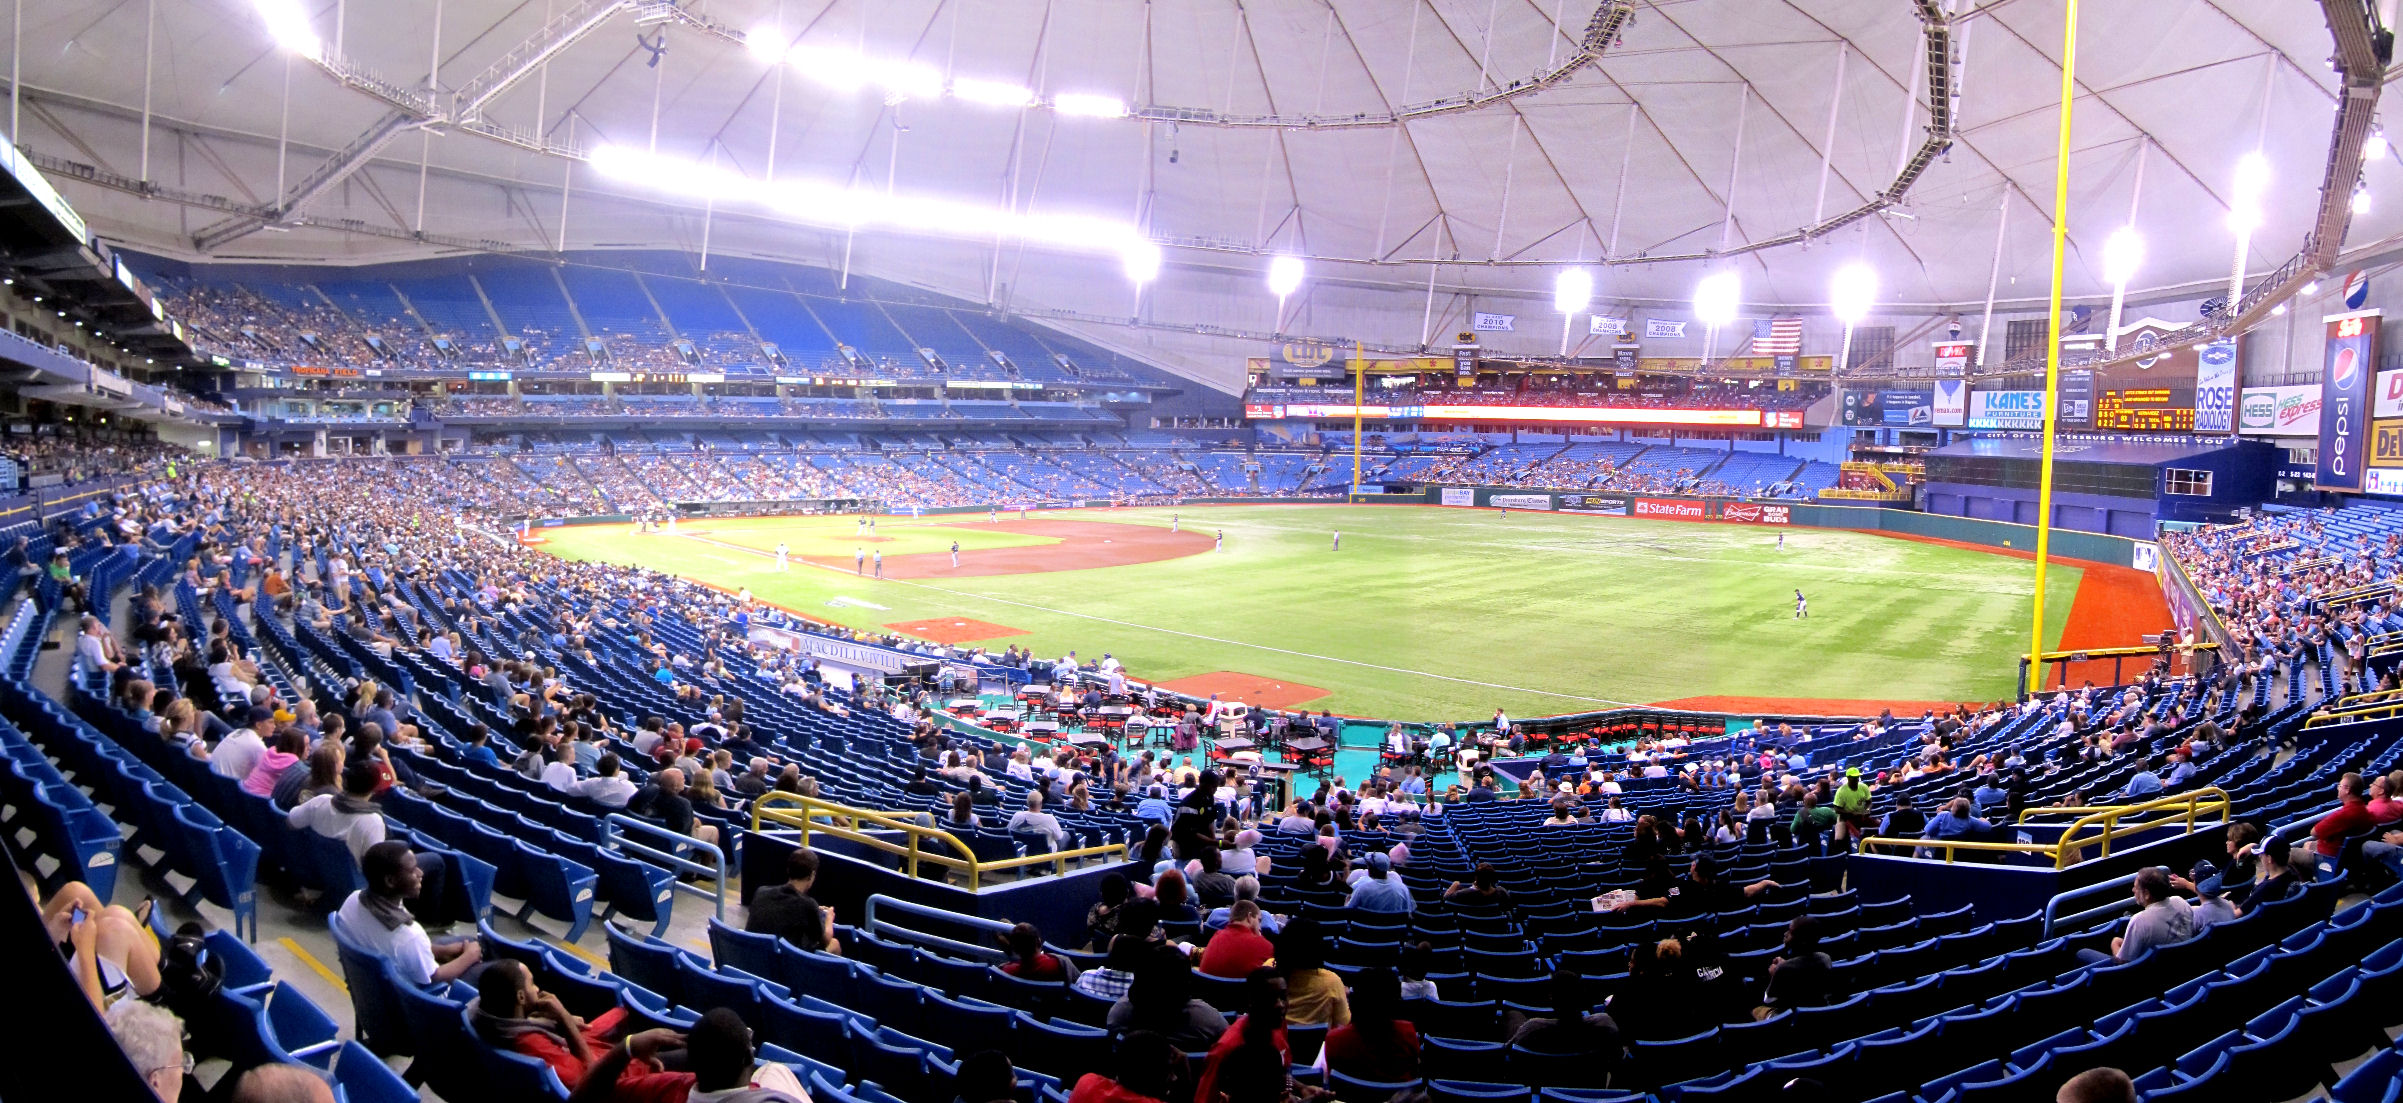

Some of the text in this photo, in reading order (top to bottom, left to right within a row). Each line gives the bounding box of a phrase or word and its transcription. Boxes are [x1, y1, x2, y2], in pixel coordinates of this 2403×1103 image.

[291, 366, 358, 376] TROPICANA FIELD
[1985, 392, 2042, 409] KANE'S
[2196, 387, 2233, 410] ROSE
[2277, 394, 2304, 411] HESS
[2244, 404, 2272, 418] HESS
[2103, 419, 2108, 427] 2
[2109, 419, 2114, 427] 2
[2195, 411, 2231, 429] RADIOLOGY
[2333, 397, 2349, 476] pepsi
[1649, 504, 1702, 517] State Farm
